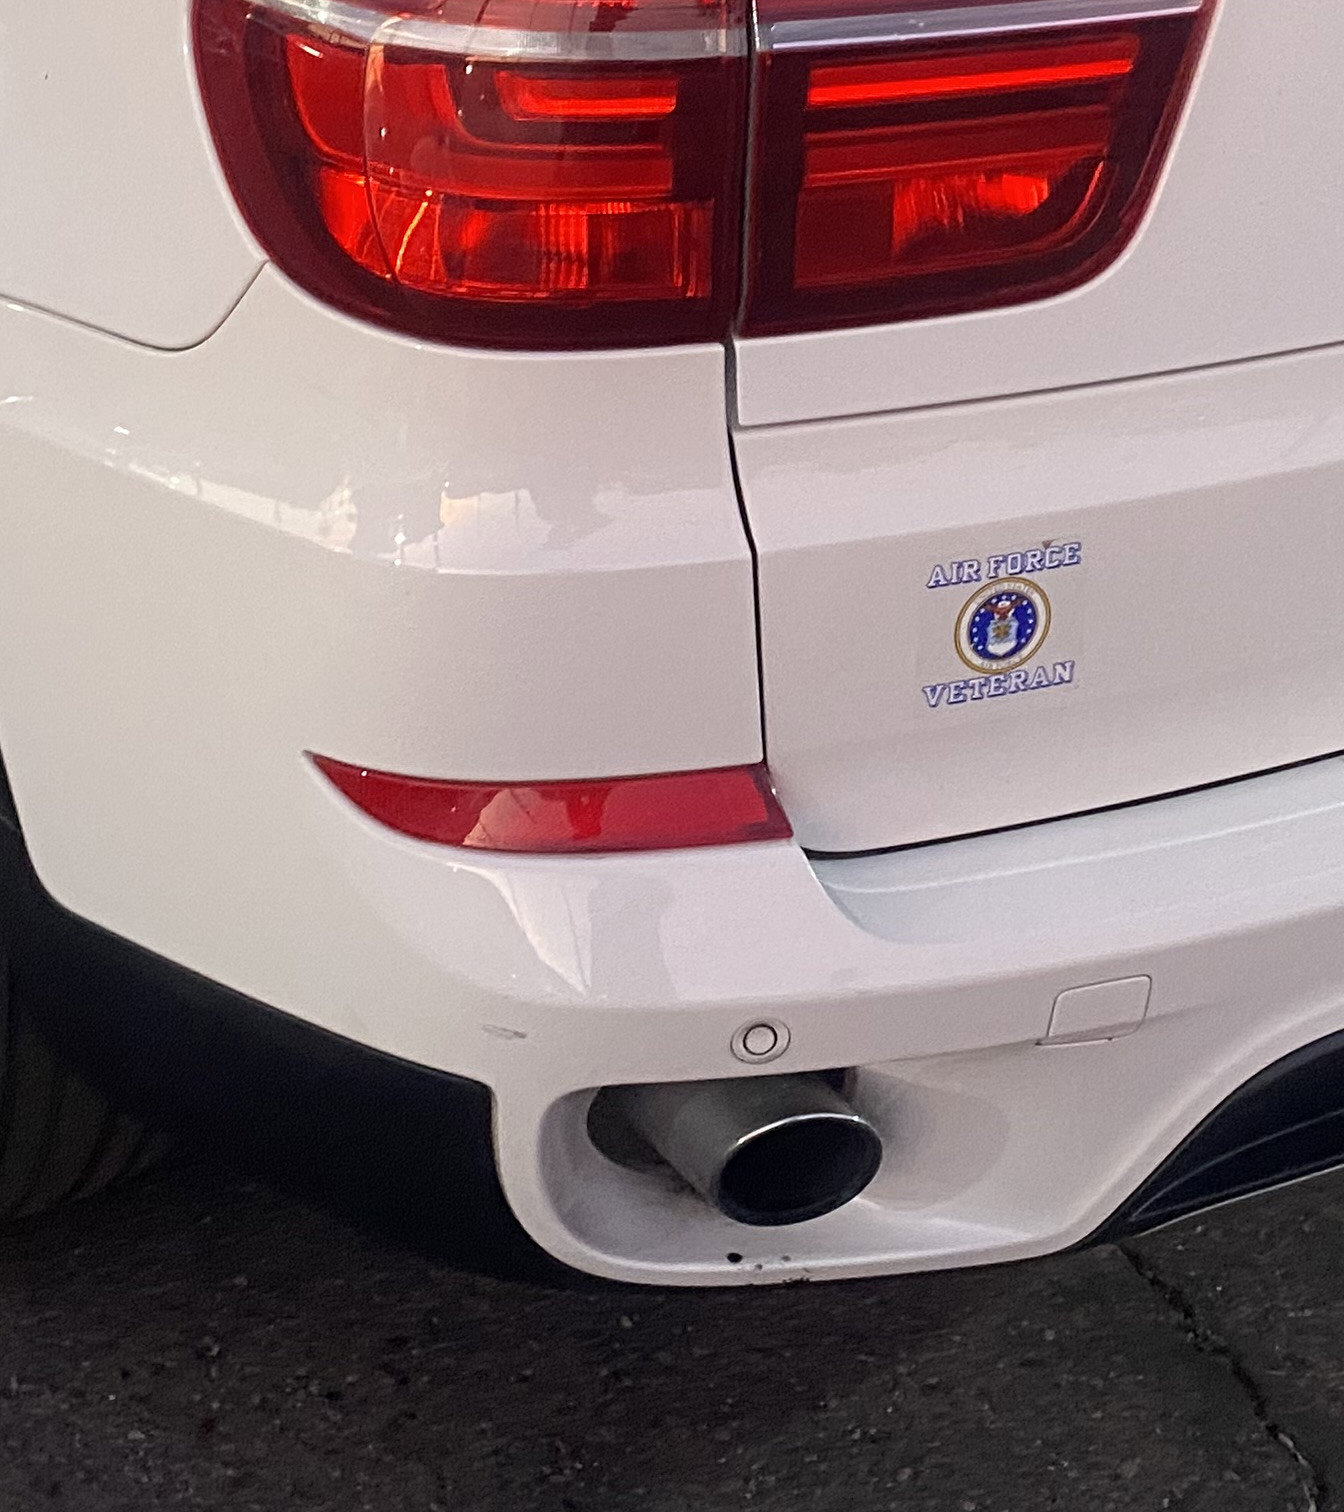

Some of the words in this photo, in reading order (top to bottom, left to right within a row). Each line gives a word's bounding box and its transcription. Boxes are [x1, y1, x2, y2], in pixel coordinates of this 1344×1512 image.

[926, 558, 981, 589] AIR
[987, 541, 1082, 579] FORCE
[922, 660, 1076, 708] VETERAN
